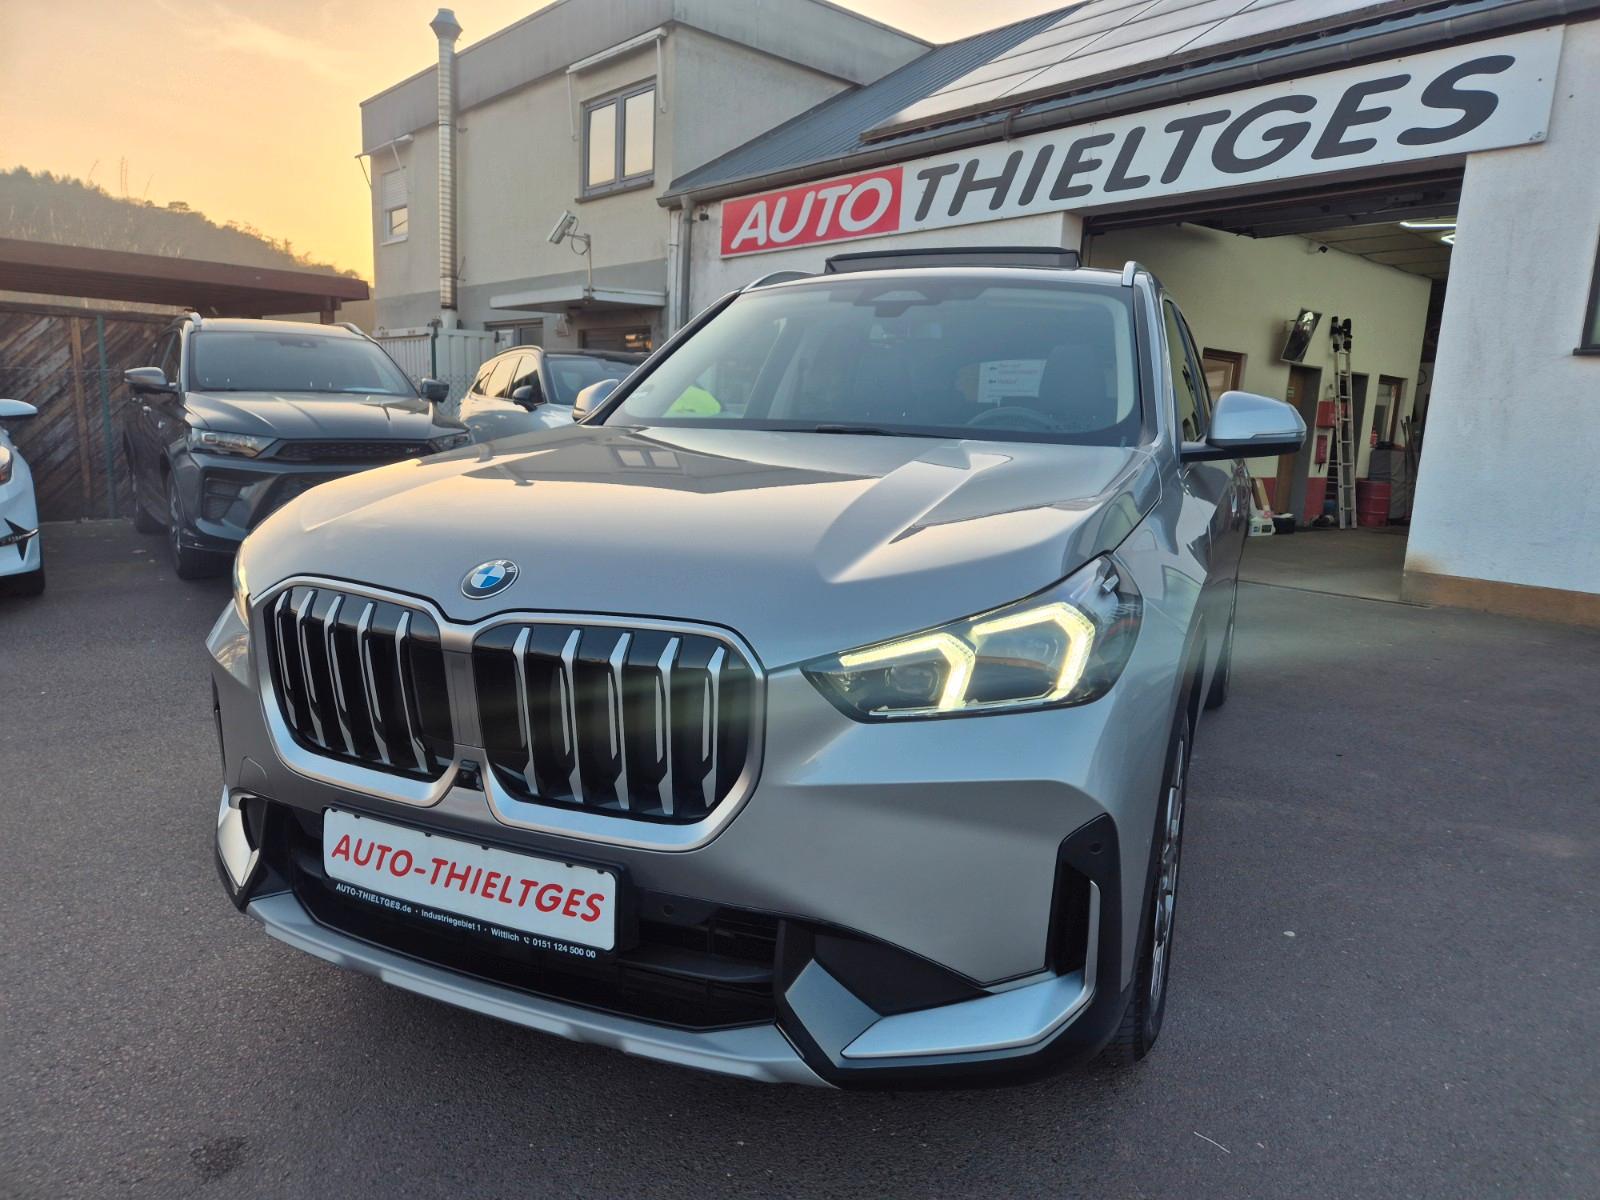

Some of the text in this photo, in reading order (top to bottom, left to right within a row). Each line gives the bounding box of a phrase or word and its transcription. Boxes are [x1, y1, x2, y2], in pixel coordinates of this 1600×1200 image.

[730, 55, 1517, 250] AUTO THIELTGES
[331, 834, 605, 922] AUTO-THIELTGES
[335, 882, 412, 913] AUTO-THIELTGES.de
[421, 908, 476, 931] Industriegebiet
[491, 927, 520, 942] Wittlich
[532, 937, 552, 950] 0151
[553, 943, 568, 954] 124
[569, 946, 584, 956] 500
[585, 949, 596, 959] 00
